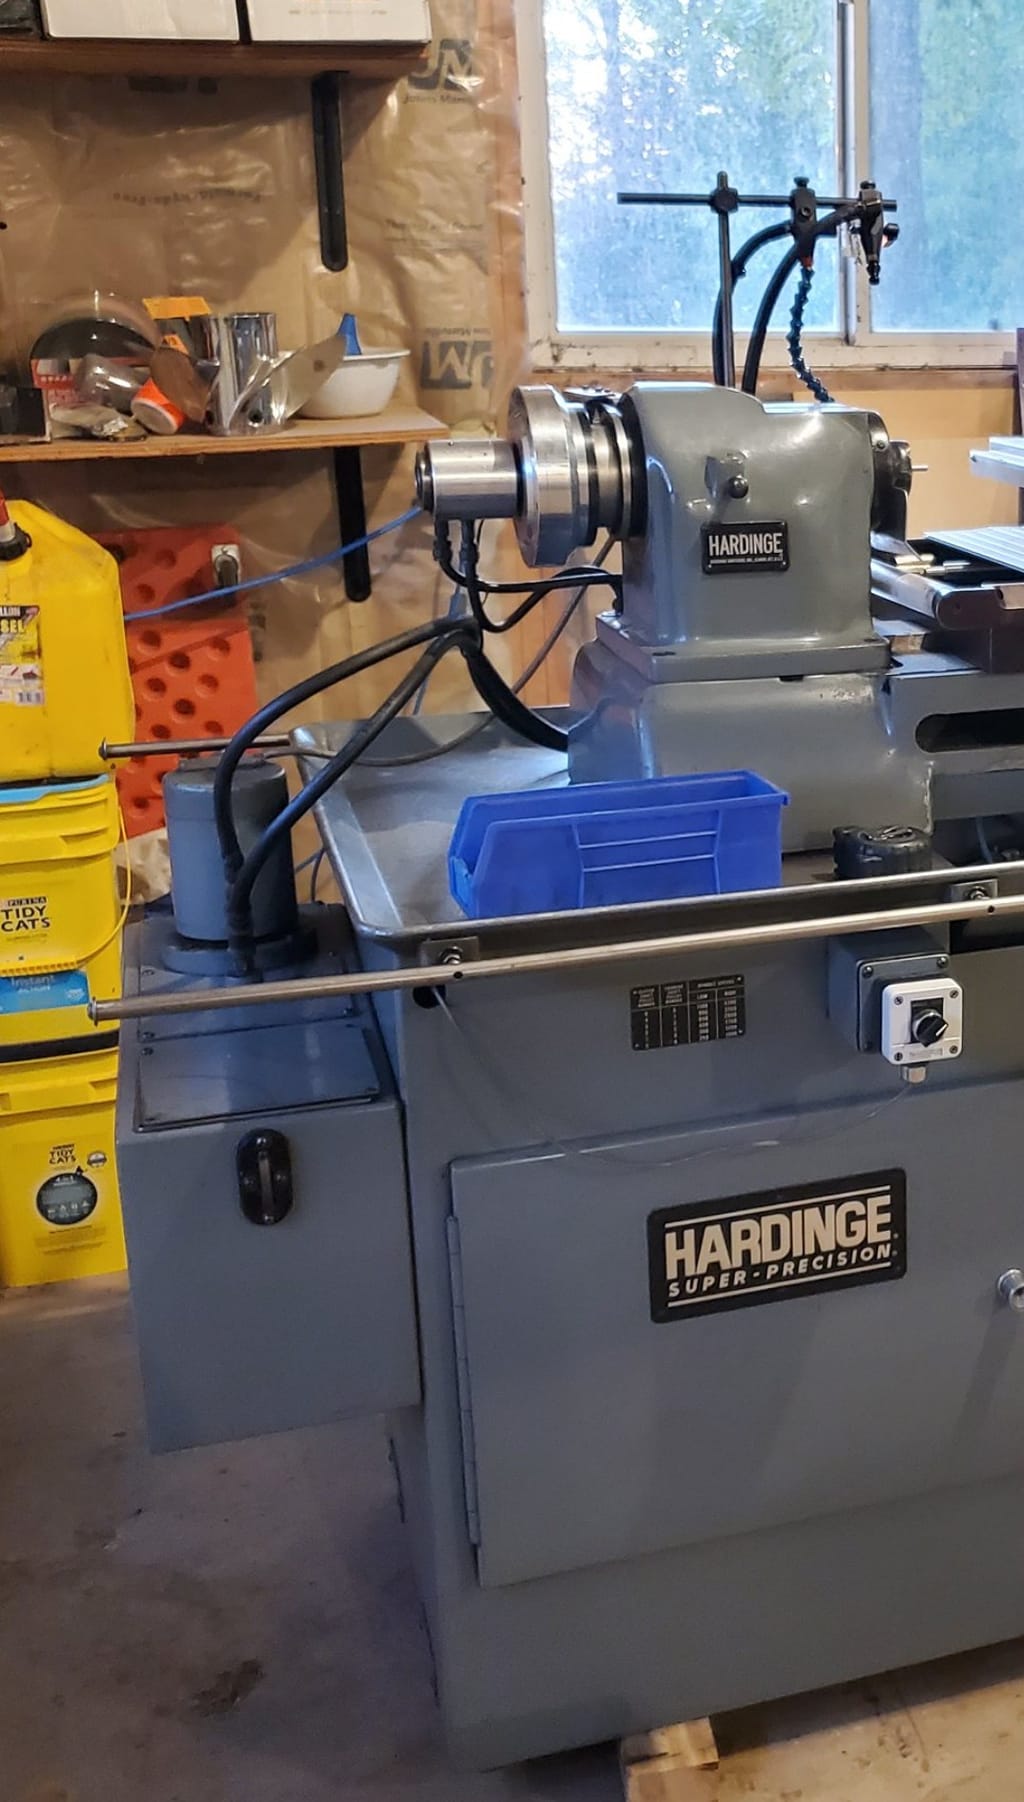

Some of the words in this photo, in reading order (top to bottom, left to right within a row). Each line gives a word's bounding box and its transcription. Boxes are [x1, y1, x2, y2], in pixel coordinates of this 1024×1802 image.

[708, 532, 783, 557] HARDINGE
[1, 905, 46, 920] TIDY
[1, 917, 51, 932] CATS
[665, 1194, 892, 1280] HARDINGE
